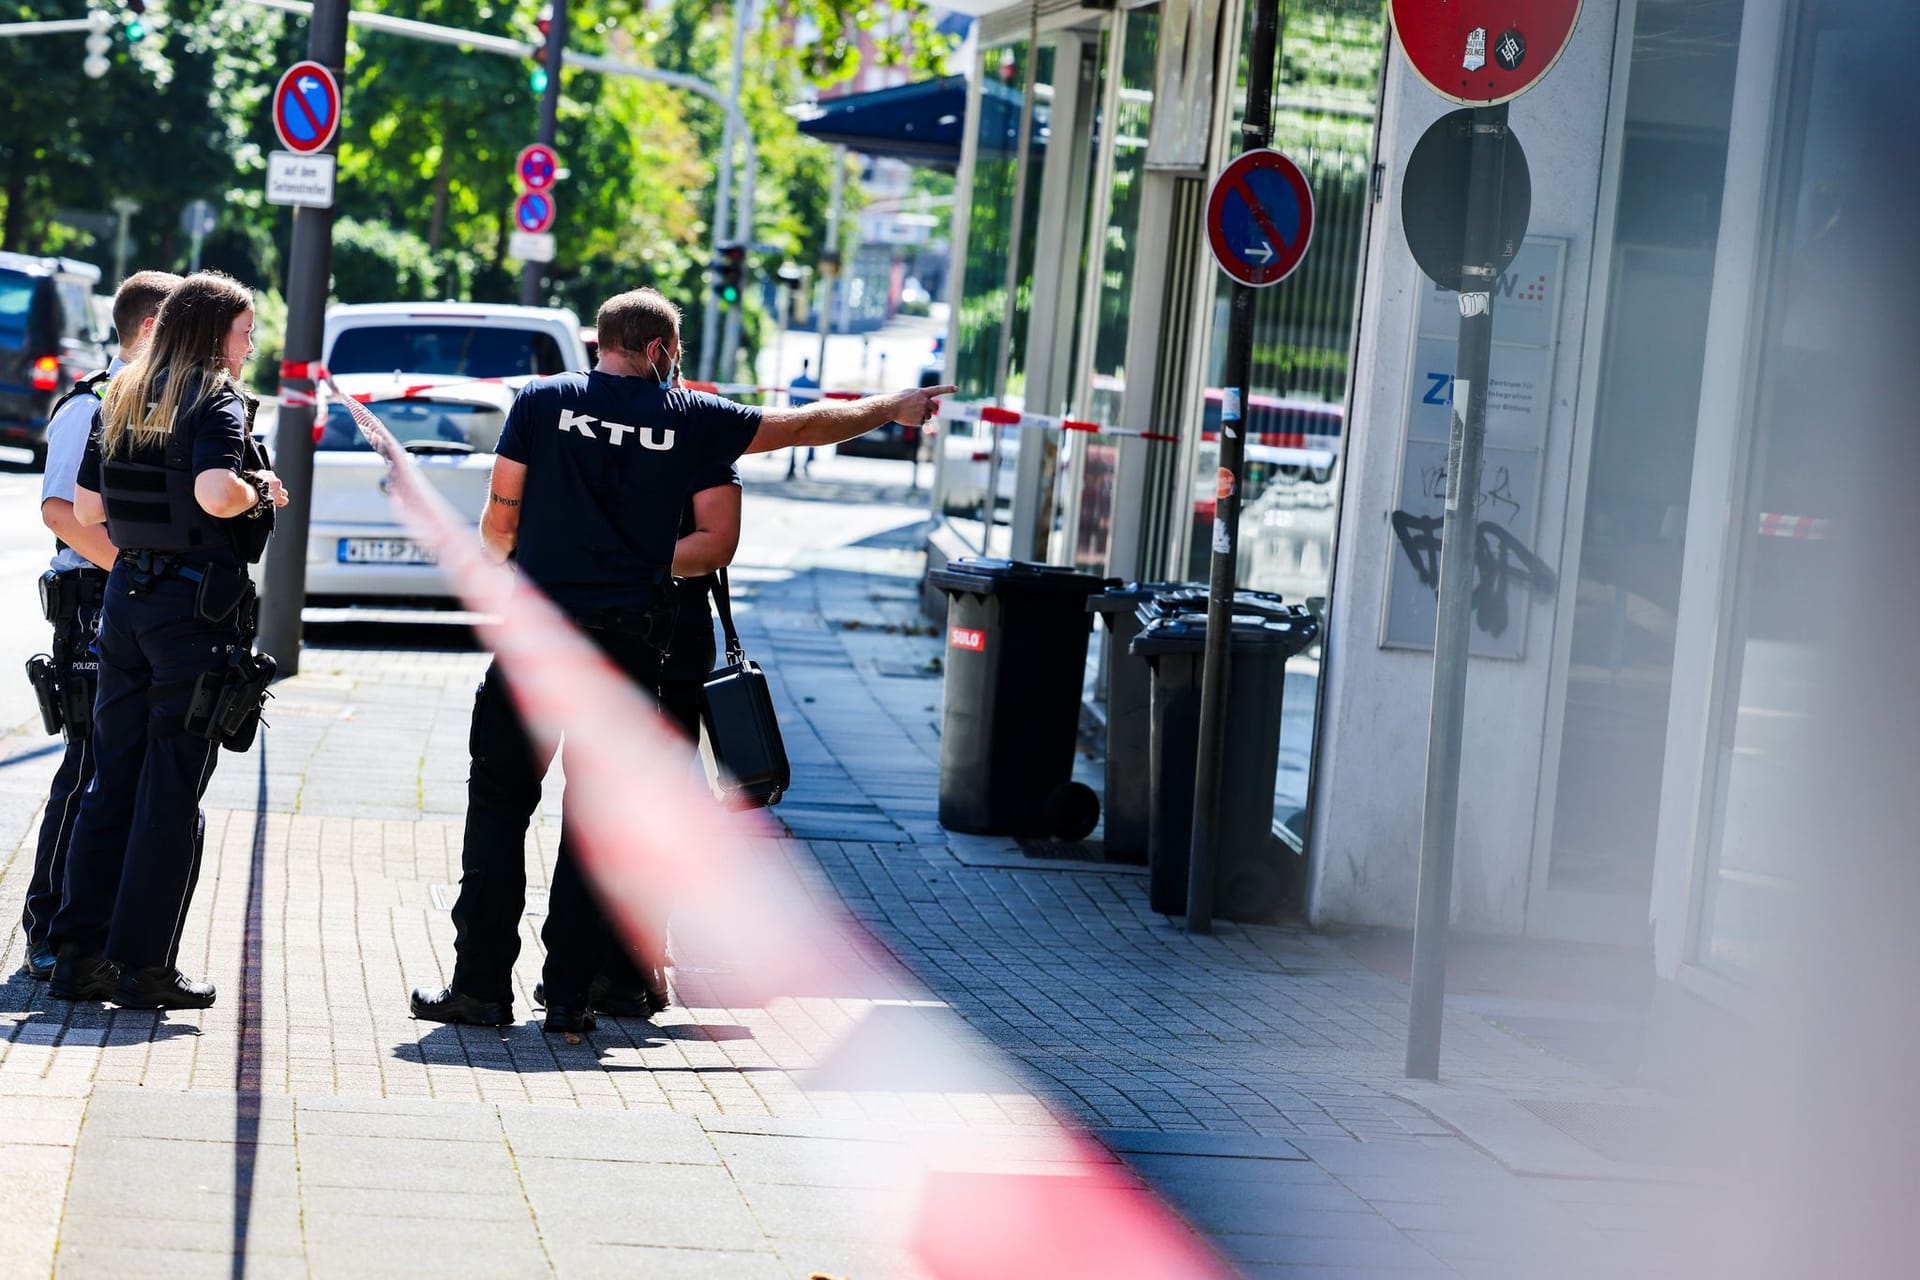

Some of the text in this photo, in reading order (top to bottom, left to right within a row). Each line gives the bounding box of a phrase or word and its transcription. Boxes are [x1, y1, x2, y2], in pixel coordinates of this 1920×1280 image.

[558, 408, 675, 451] KTU
[952, 629, 979, 647] SULO
[72, 662, 99, 671] POLIZEI
